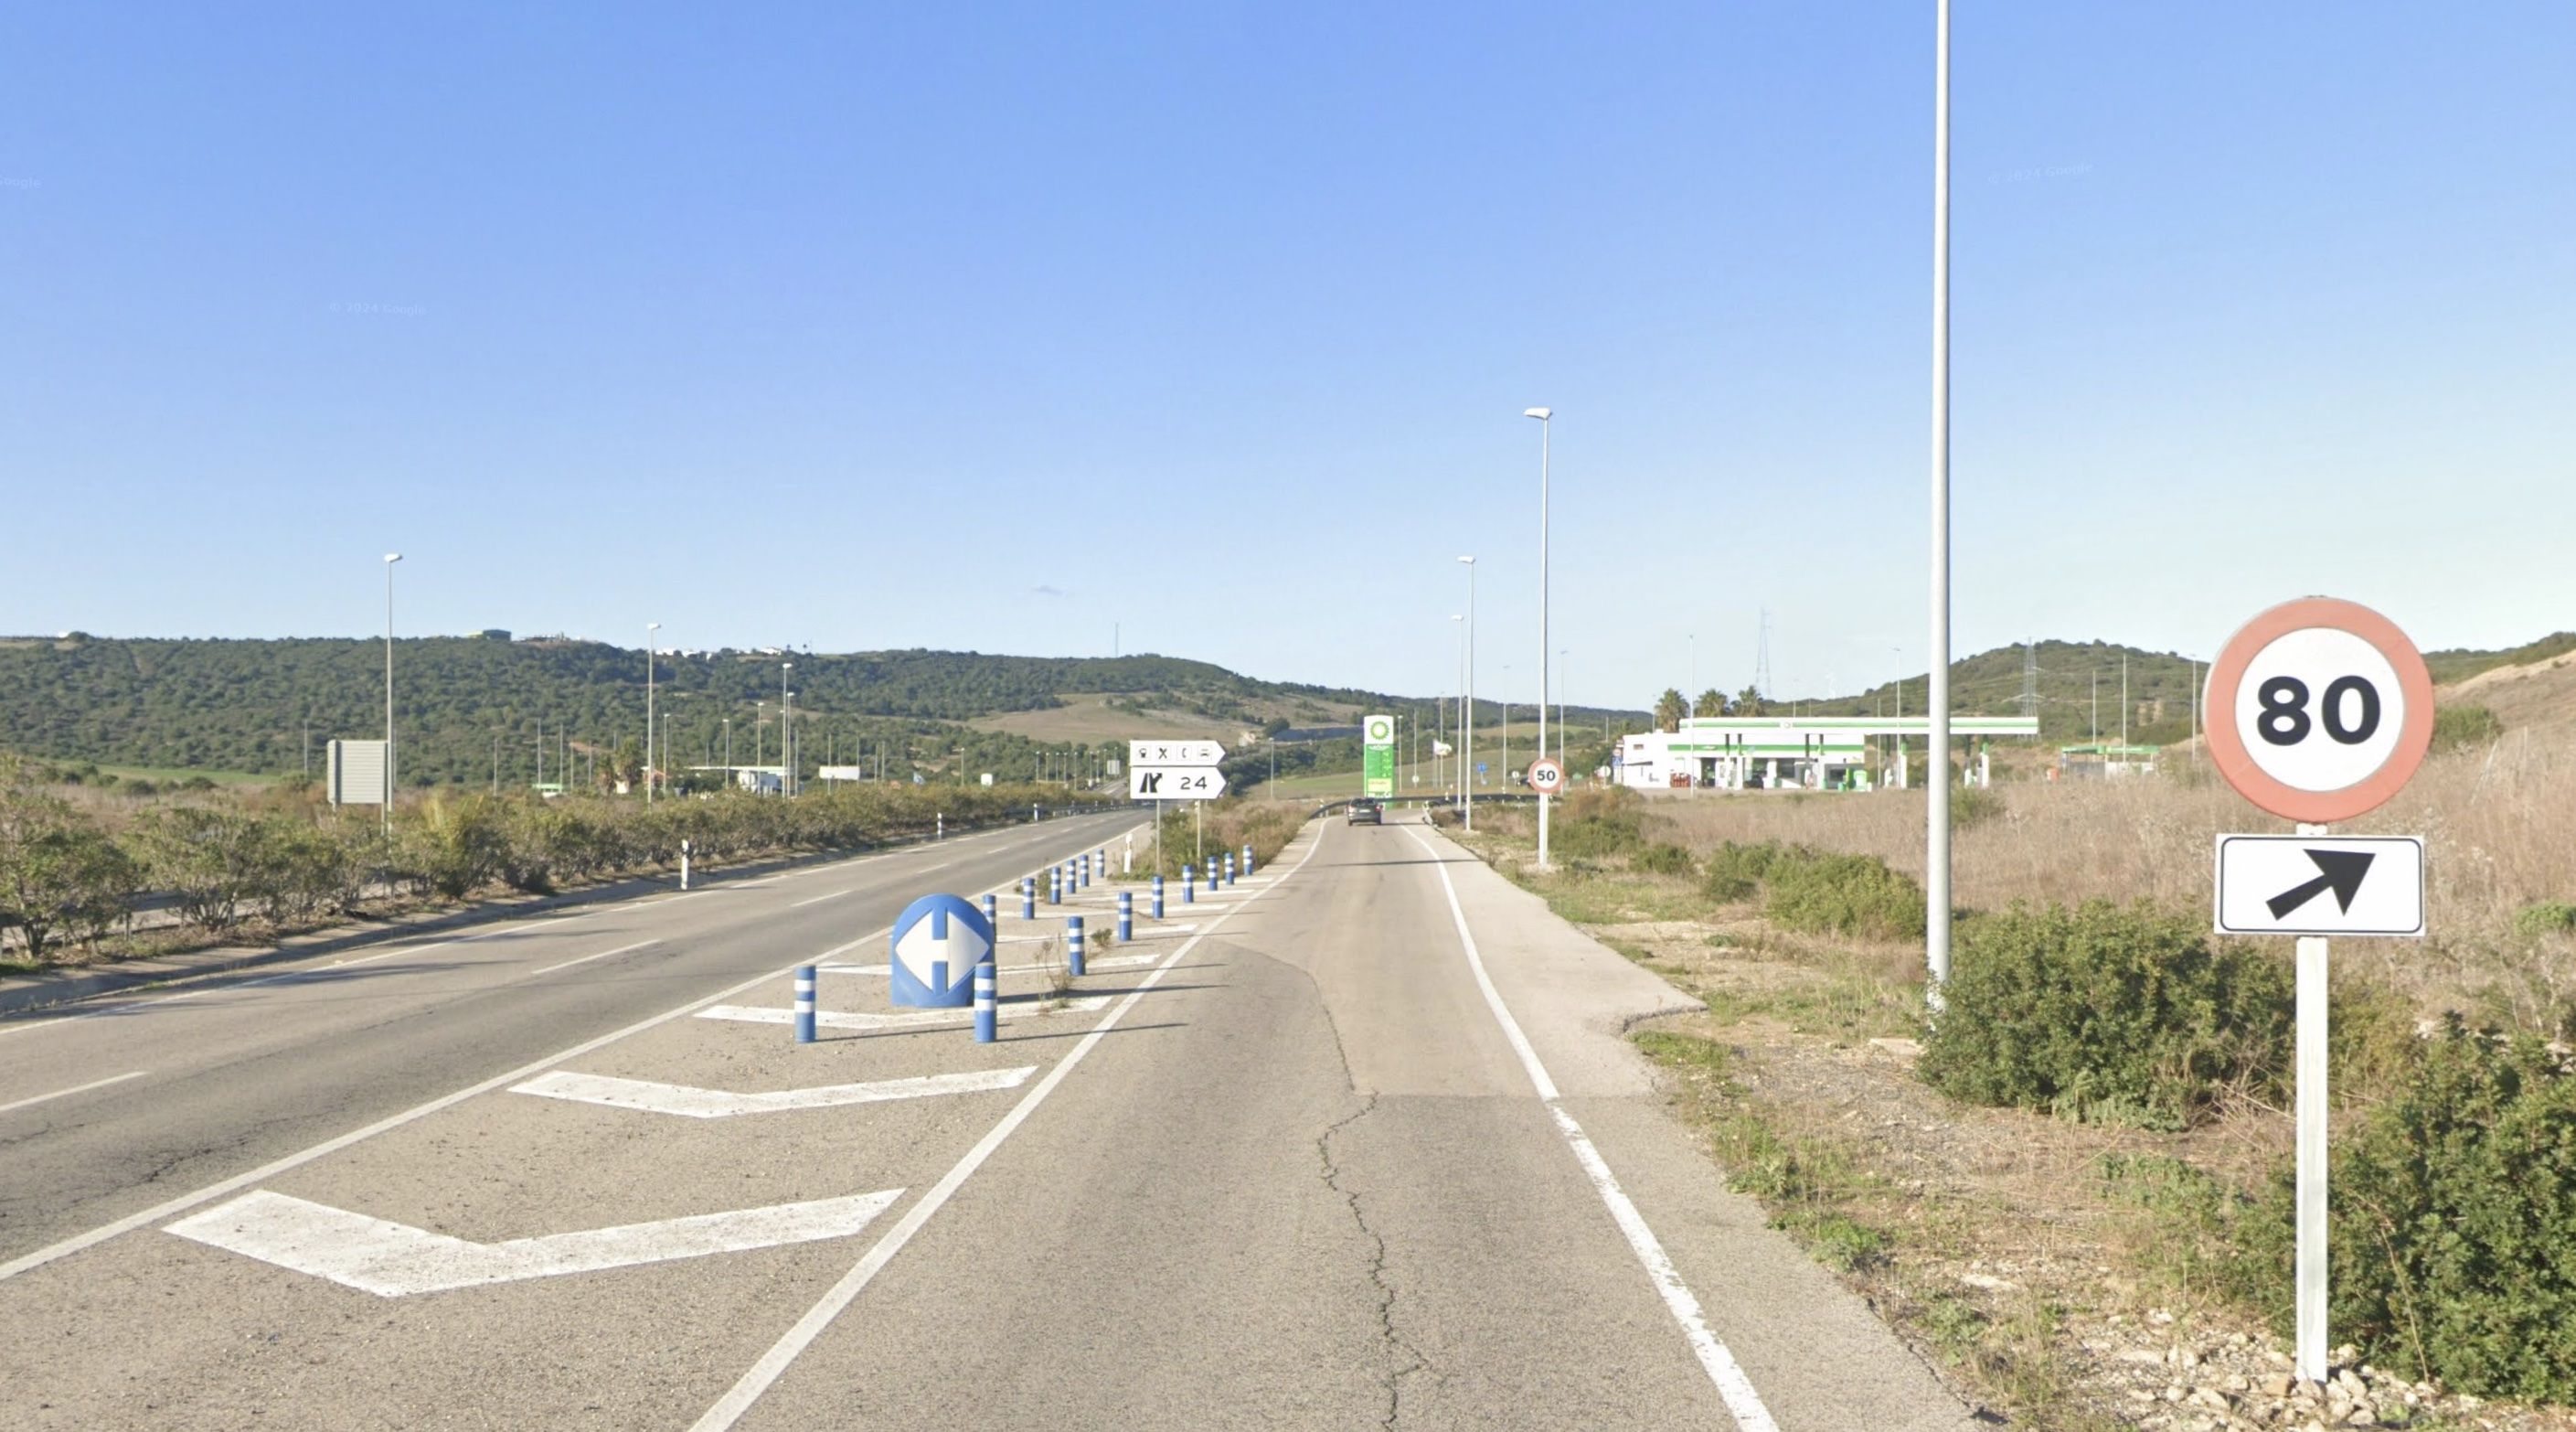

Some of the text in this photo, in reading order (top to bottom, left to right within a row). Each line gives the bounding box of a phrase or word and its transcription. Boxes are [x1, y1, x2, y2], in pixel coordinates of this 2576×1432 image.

[2257, 675, 2380, 746] 80
[1537, 770, 1556, 781] 50
[1180, 776, 1208, 790] 24
